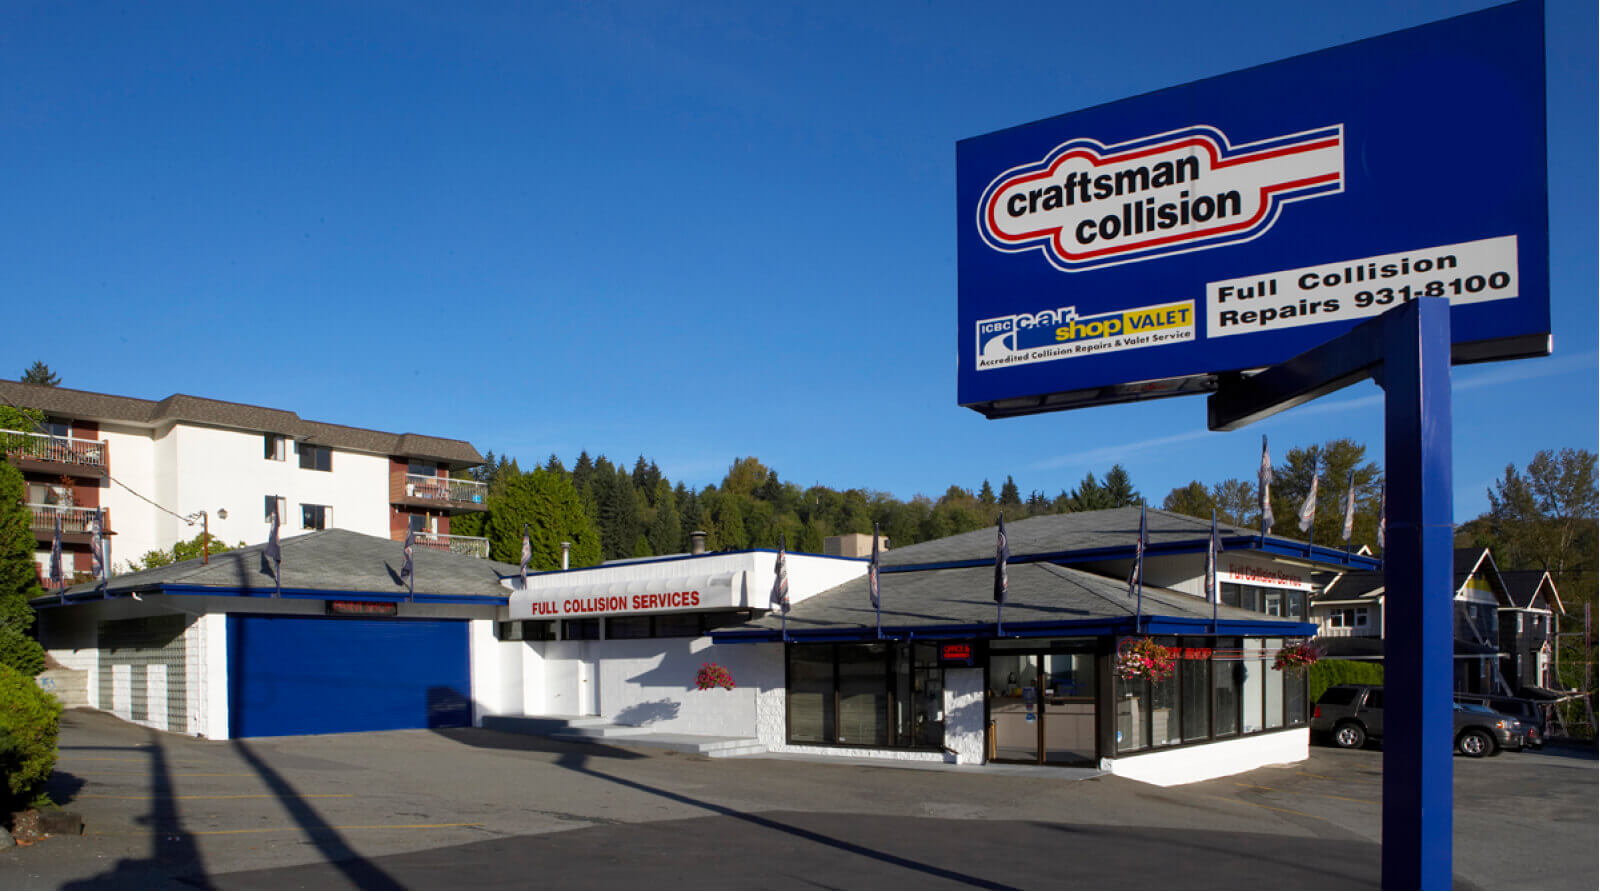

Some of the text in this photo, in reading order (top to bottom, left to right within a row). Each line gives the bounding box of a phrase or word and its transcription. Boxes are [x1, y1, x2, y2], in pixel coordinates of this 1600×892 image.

[1007, 154, 1200, 217] craftsman
[1075, 190, 1241, 245] collision
[1218, 254, 1457, 303] Full Collision
[1219, 270, 1511, 327] Repairs 931-8100
[981, 321, 1011, 334] ICBC
[1055, 308, 1190, 341] shop VALET
[980, 330, 1191, 367] Accredited Collision Repairs & Valet Service
[532, 590, 700, 616] FULL COLLISION SERVICES
